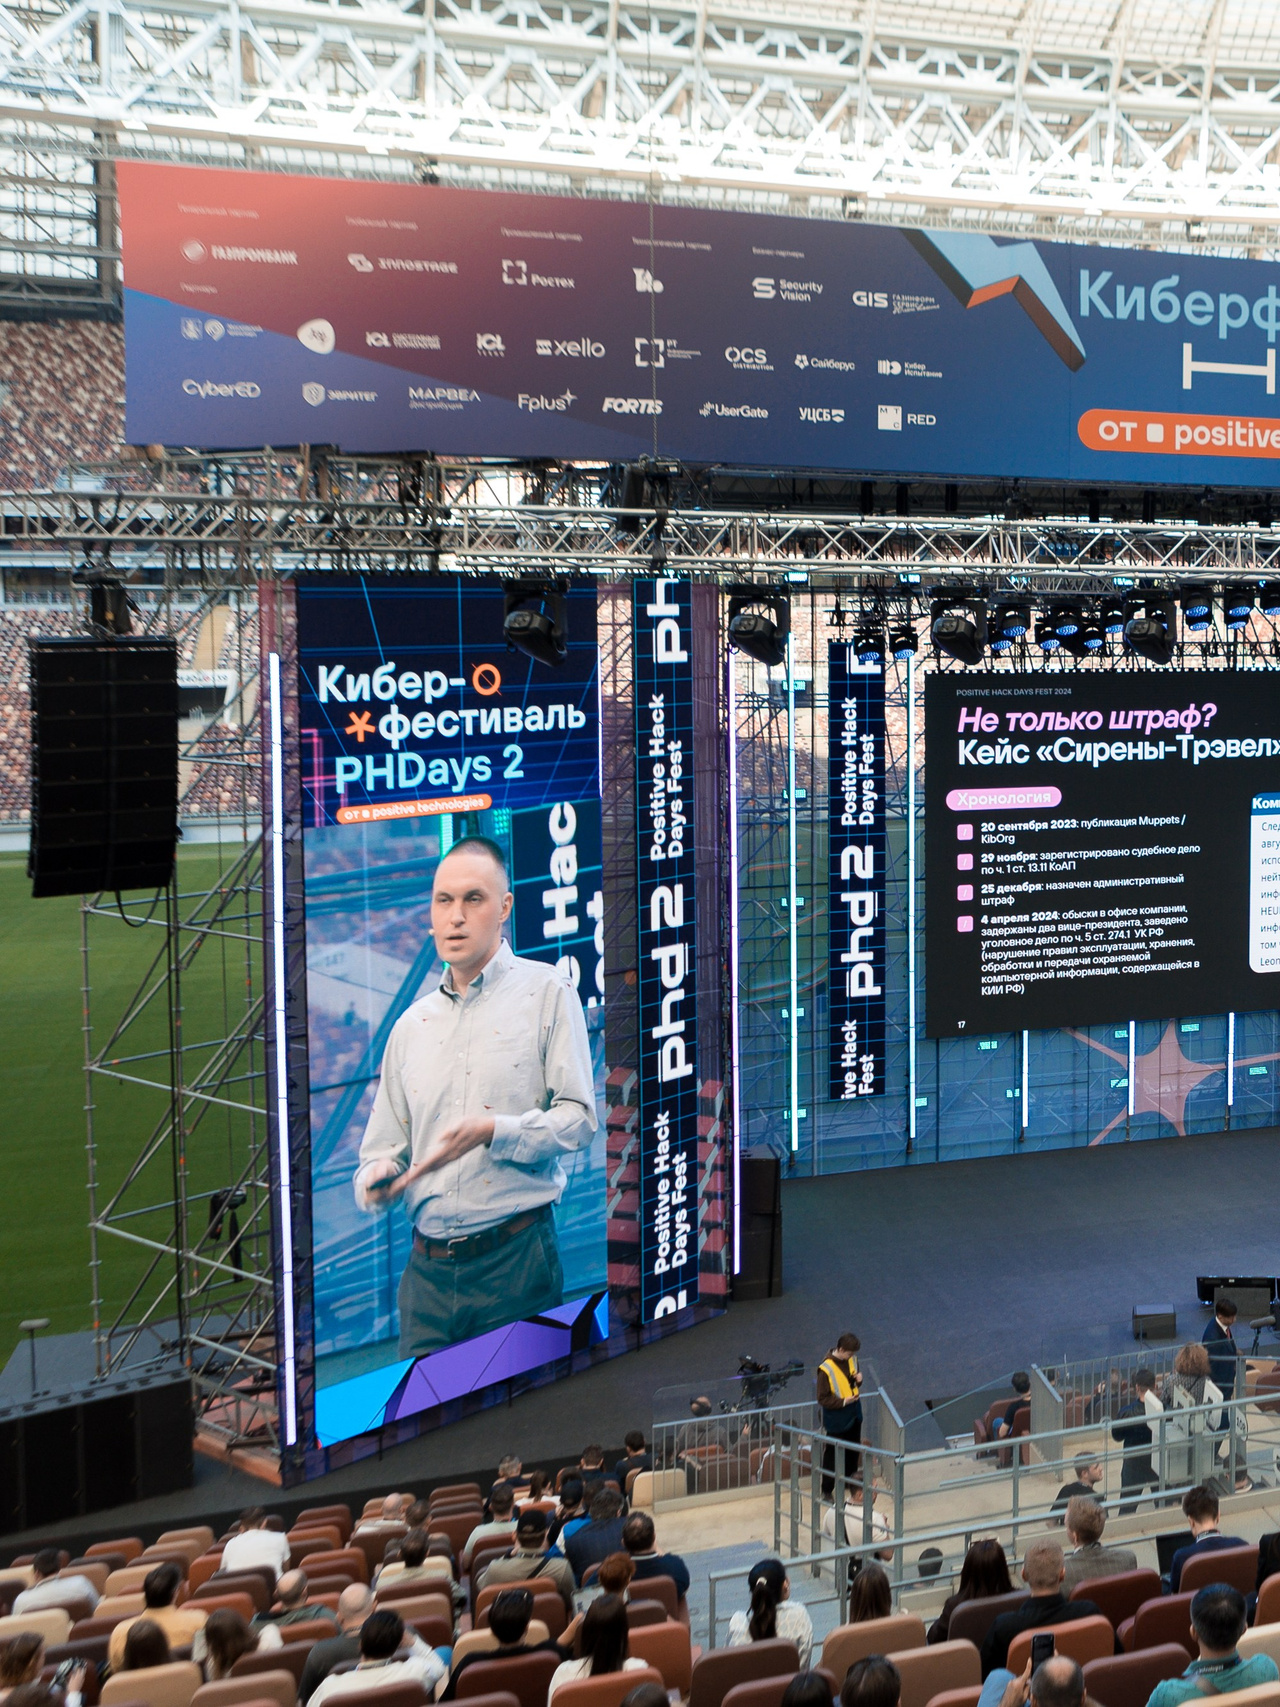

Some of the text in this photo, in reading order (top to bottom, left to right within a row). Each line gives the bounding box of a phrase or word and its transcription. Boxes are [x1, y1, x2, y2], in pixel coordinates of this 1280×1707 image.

[780, 279, 823, 294] Security
[780, 290, 811, 302] Vision
[852, 291, 888, 308] GIS
[554, 337, 605, 358] xello
[725, 346, 767, 364] OCS
[811, 357, 855, 371] Сайберус
[905, 362, 926, 371] Кибер
[905, 369, 942, 378] Испытание
[602, 397, 663, 415] FORTIS
[715, 404, 768, 419] UserGate
[800, 408, 831, 423] УЦСБ
[907, 414, 936, 425] RED
[1099, 420, 1137, 442] от
[318, 662, 466, 704] Кибер-
[1014, 688, 1033, 696] DAYS
[379, 703, 586, 750] фестиваль
[958, 703, 1217, 735] Не только штраф?
[958, 738, 1029, 765] Кейс
[335, 751, 492, 794] PHDays
[648, 693, 667, 861] Positive Hack
[667, 740, 686, 858] Days Fest
[958, 792, 1051, 808] Хронология
[372, 798, 484, 819] positive technologies
[981, 815, 1180, 832] 20 сентября 2023: публикация Muppets
[981, 834, 1015, 845] KibOrg
[981, 845, 1200, 863] 29 ноября: зарегистрировано судебное дело
[982, 861, 1076, 875] по 13.11 КоАП
[981, 874, 1184, 894] 25 декабря: назначен административный
[650, 883, 684, 931] 2
[981, 895, 1015, 906] штраф
[981, 905, 1188, 925] 4 апреля 2024: обыски офисе компании,
[981, 915, 1188, 936] задержаны два вице-президента, заведено
[981, 928, 1164, 949] уголовное дело по 274.1 УК РФ
[1260, 941, 1276, 949] том
[981, 937, 1195, 962] (нарушение правил эксплуатации, хранения,
[981, 951, 1150, 973] обработки передачи охраняемой
[981, 960, 1192, 984] компьютерной информации, содержащейся
[981, 984, 1024, 996] КИИ РФ)
[958, 1020, 966, 1029] 17
